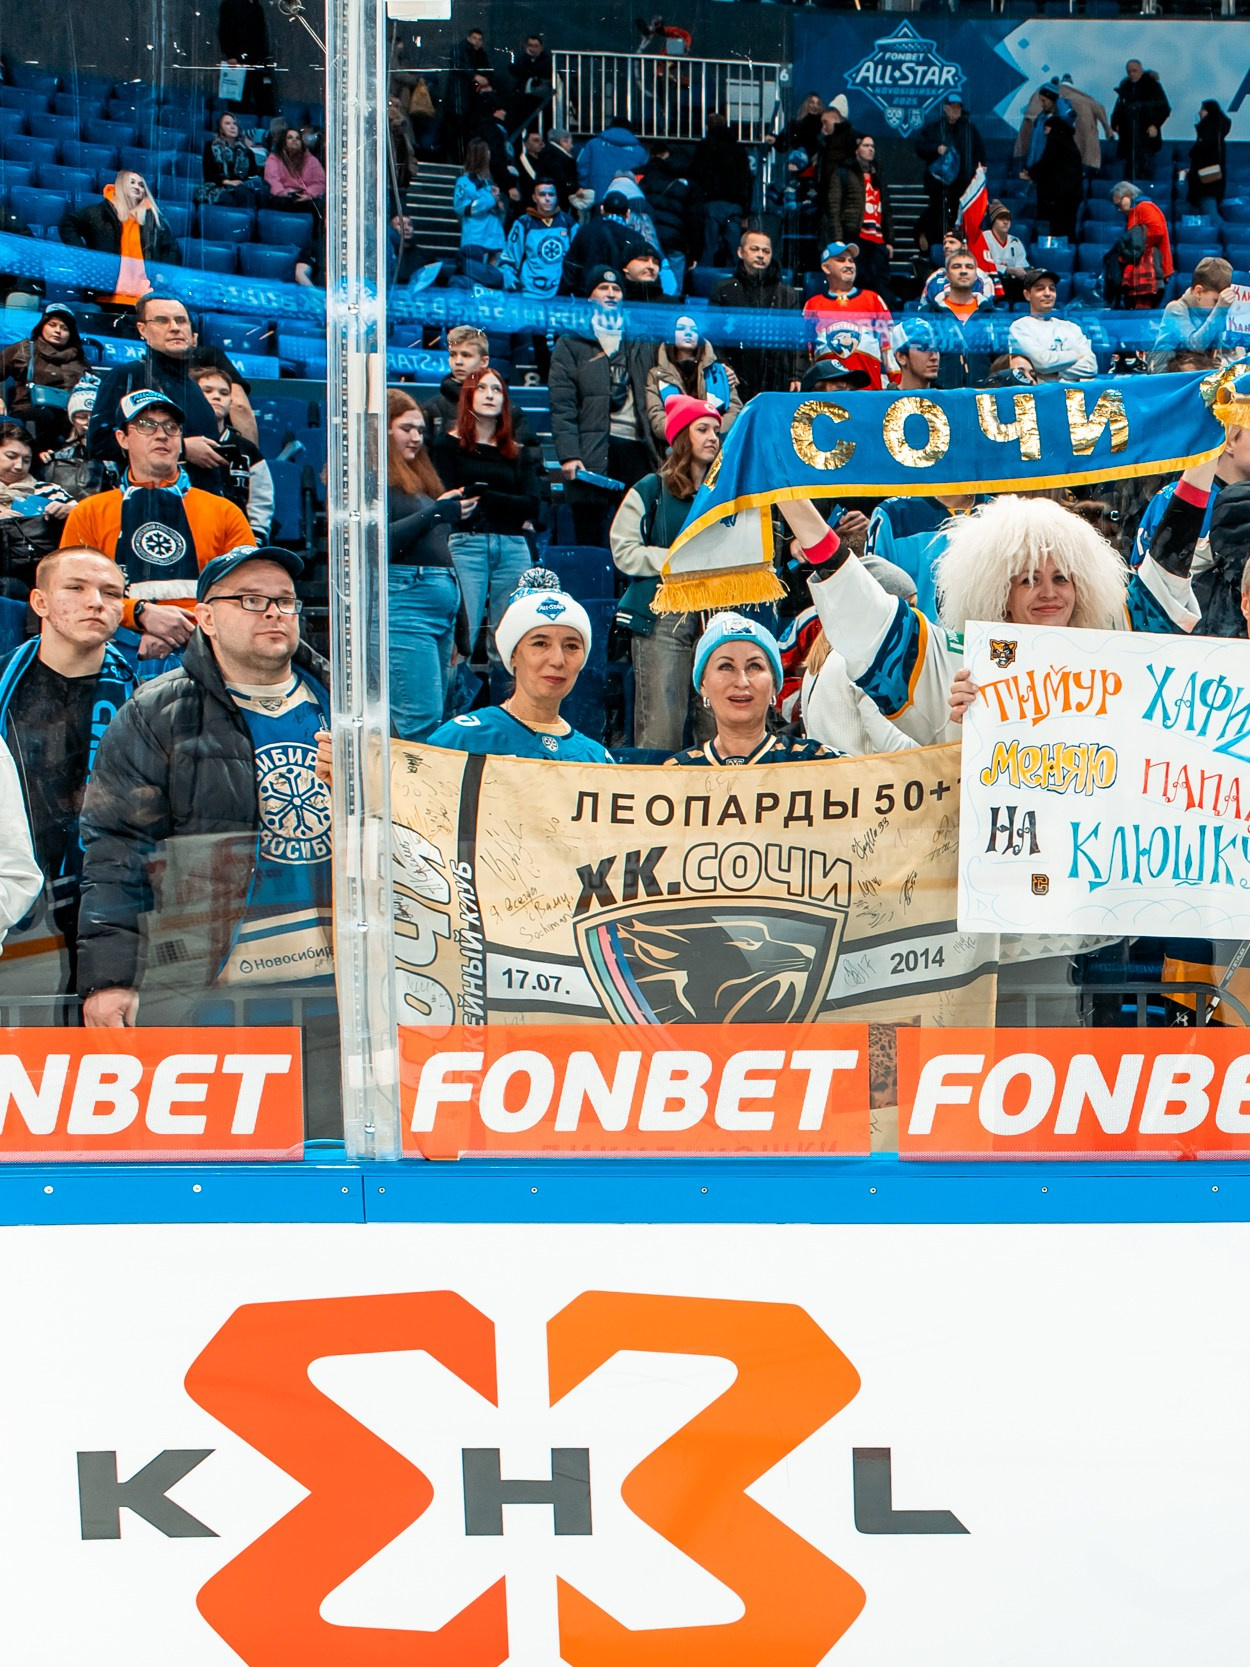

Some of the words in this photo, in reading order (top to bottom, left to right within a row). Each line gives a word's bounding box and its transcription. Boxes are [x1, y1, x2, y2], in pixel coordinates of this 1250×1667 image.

[885, 52, 925, 61] FONBET
[791, 388, 1129, 470] СОЧИ
[571, 786, 860, 829] ЛЕОПАРДЫ
[985, 805, 1041, 856] НА
[449, 859, 480, 925] КЛУБ
[572, 841, 853, 917] ХК.СОЧИ
[501, 966, 571, 996] 17.07.
[889, 945, 945, 975] 2014
[411, 1049, 859, 1133] FONBET
